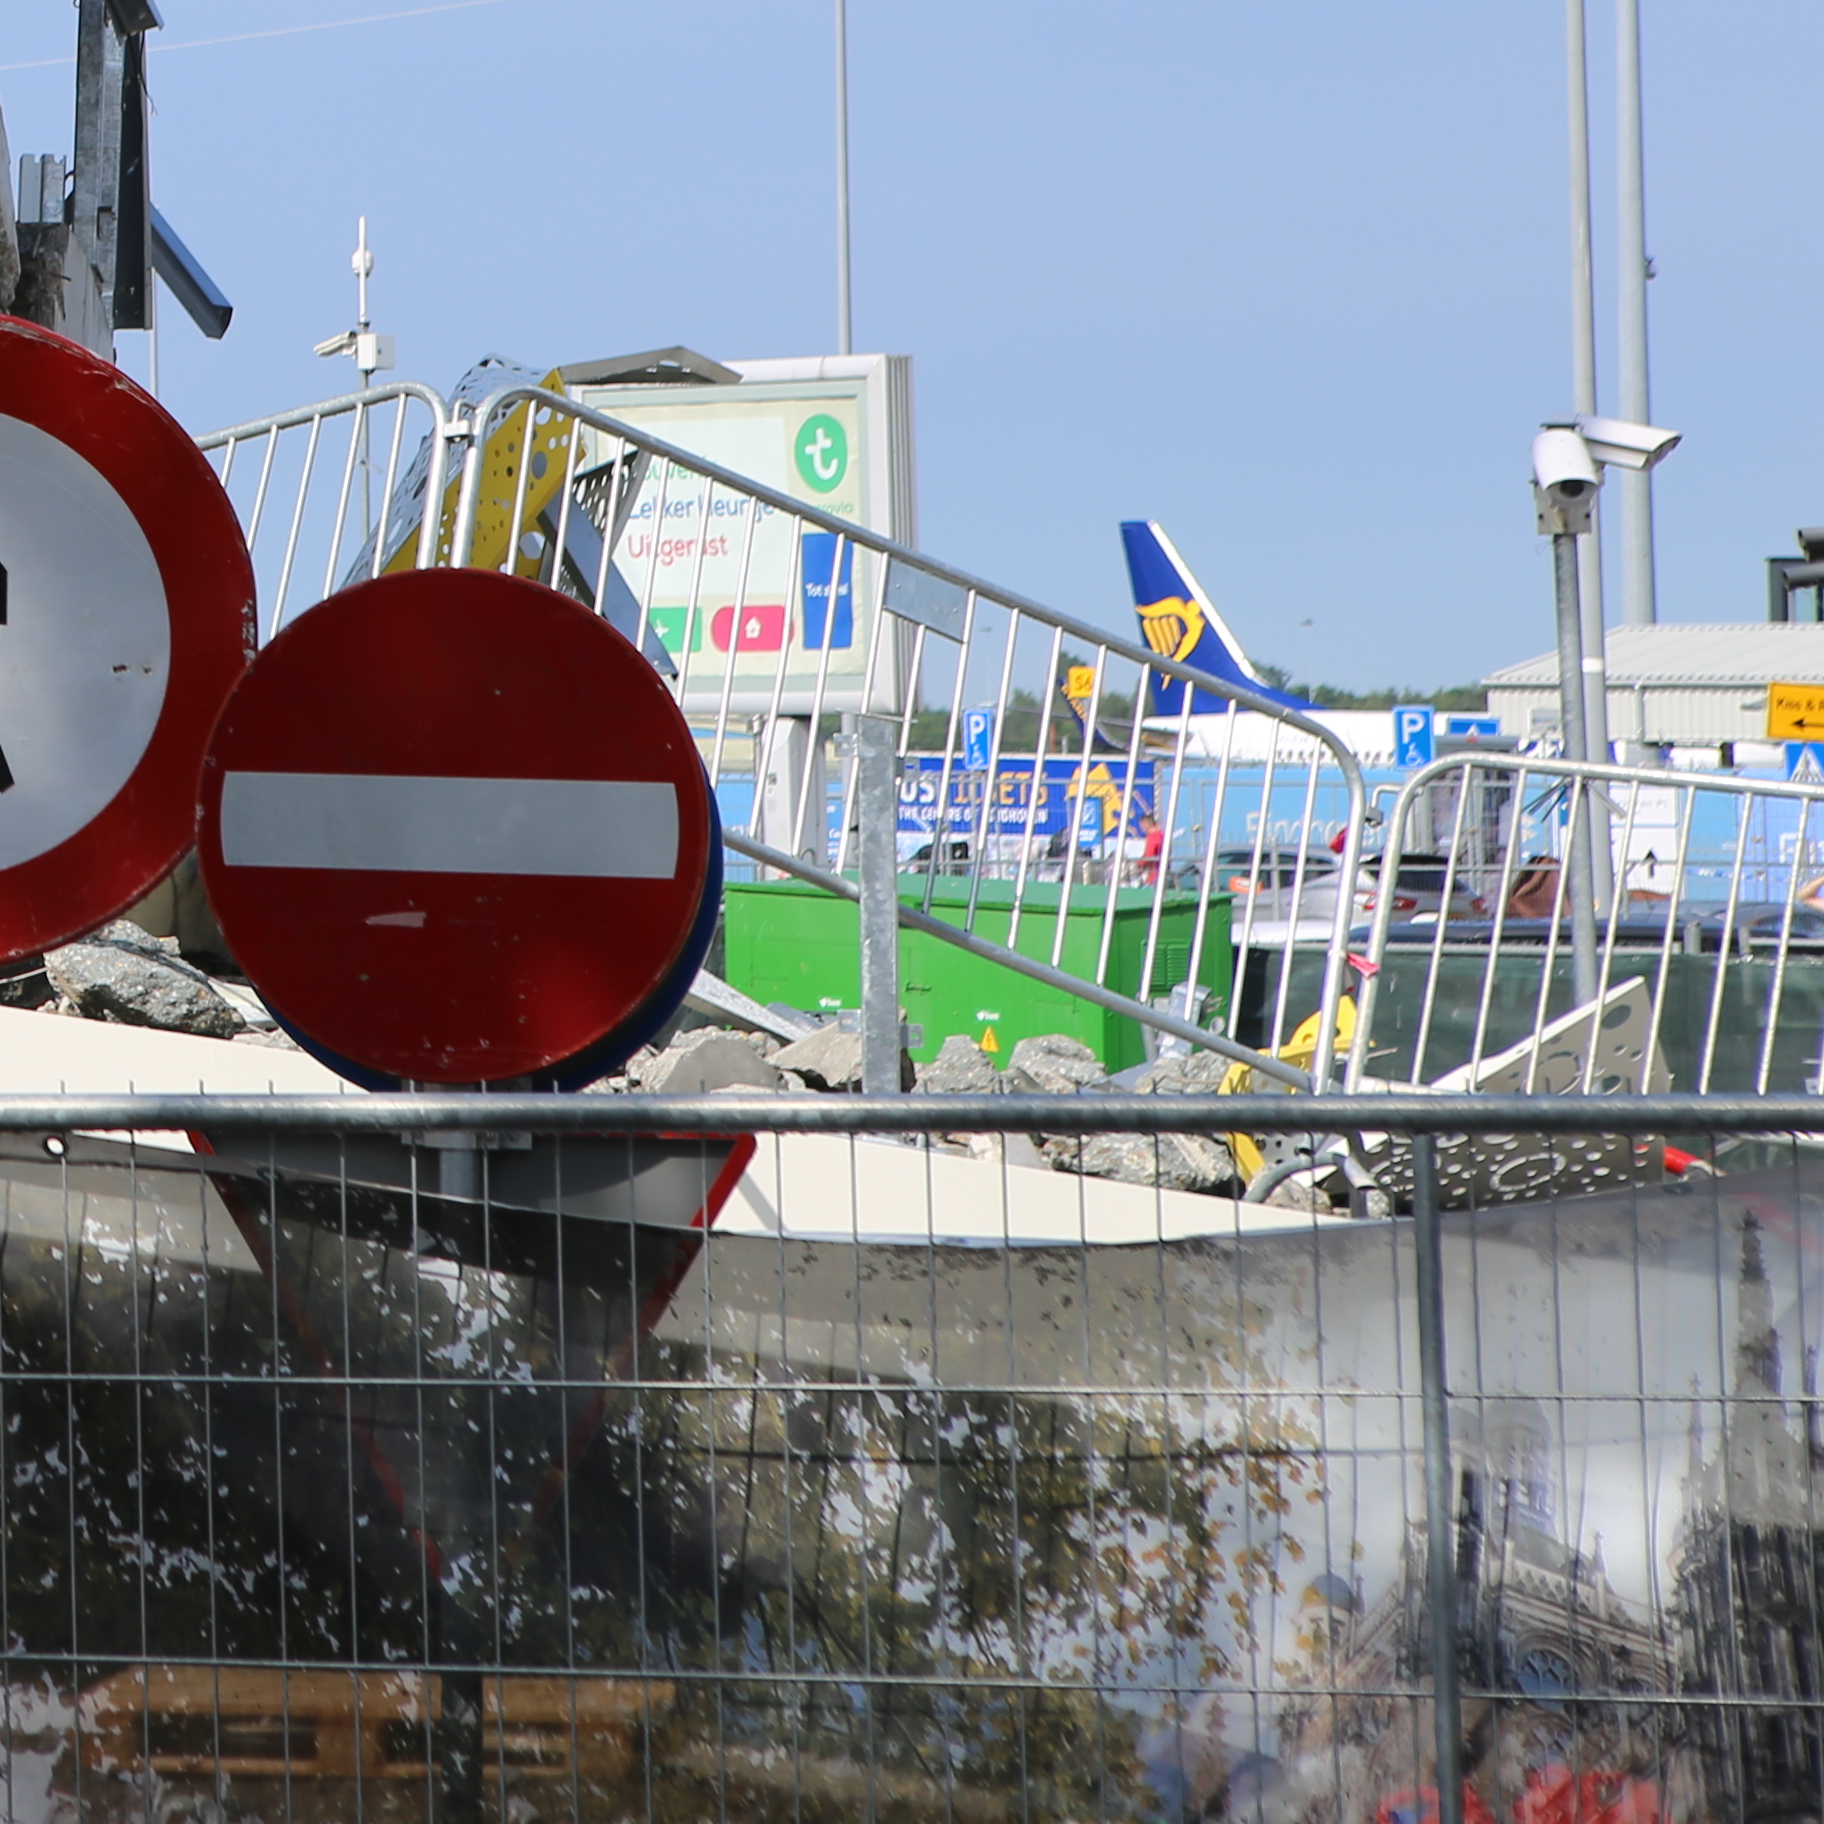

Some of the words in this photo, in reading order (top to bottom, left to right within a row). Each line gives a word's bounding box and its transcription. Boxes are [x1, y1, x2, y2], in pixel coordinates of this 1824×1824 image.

[627, 532, 729, 567] Uigerst
[969, 715, 985, 746] P
[1402, 713, 1425, 745] P
